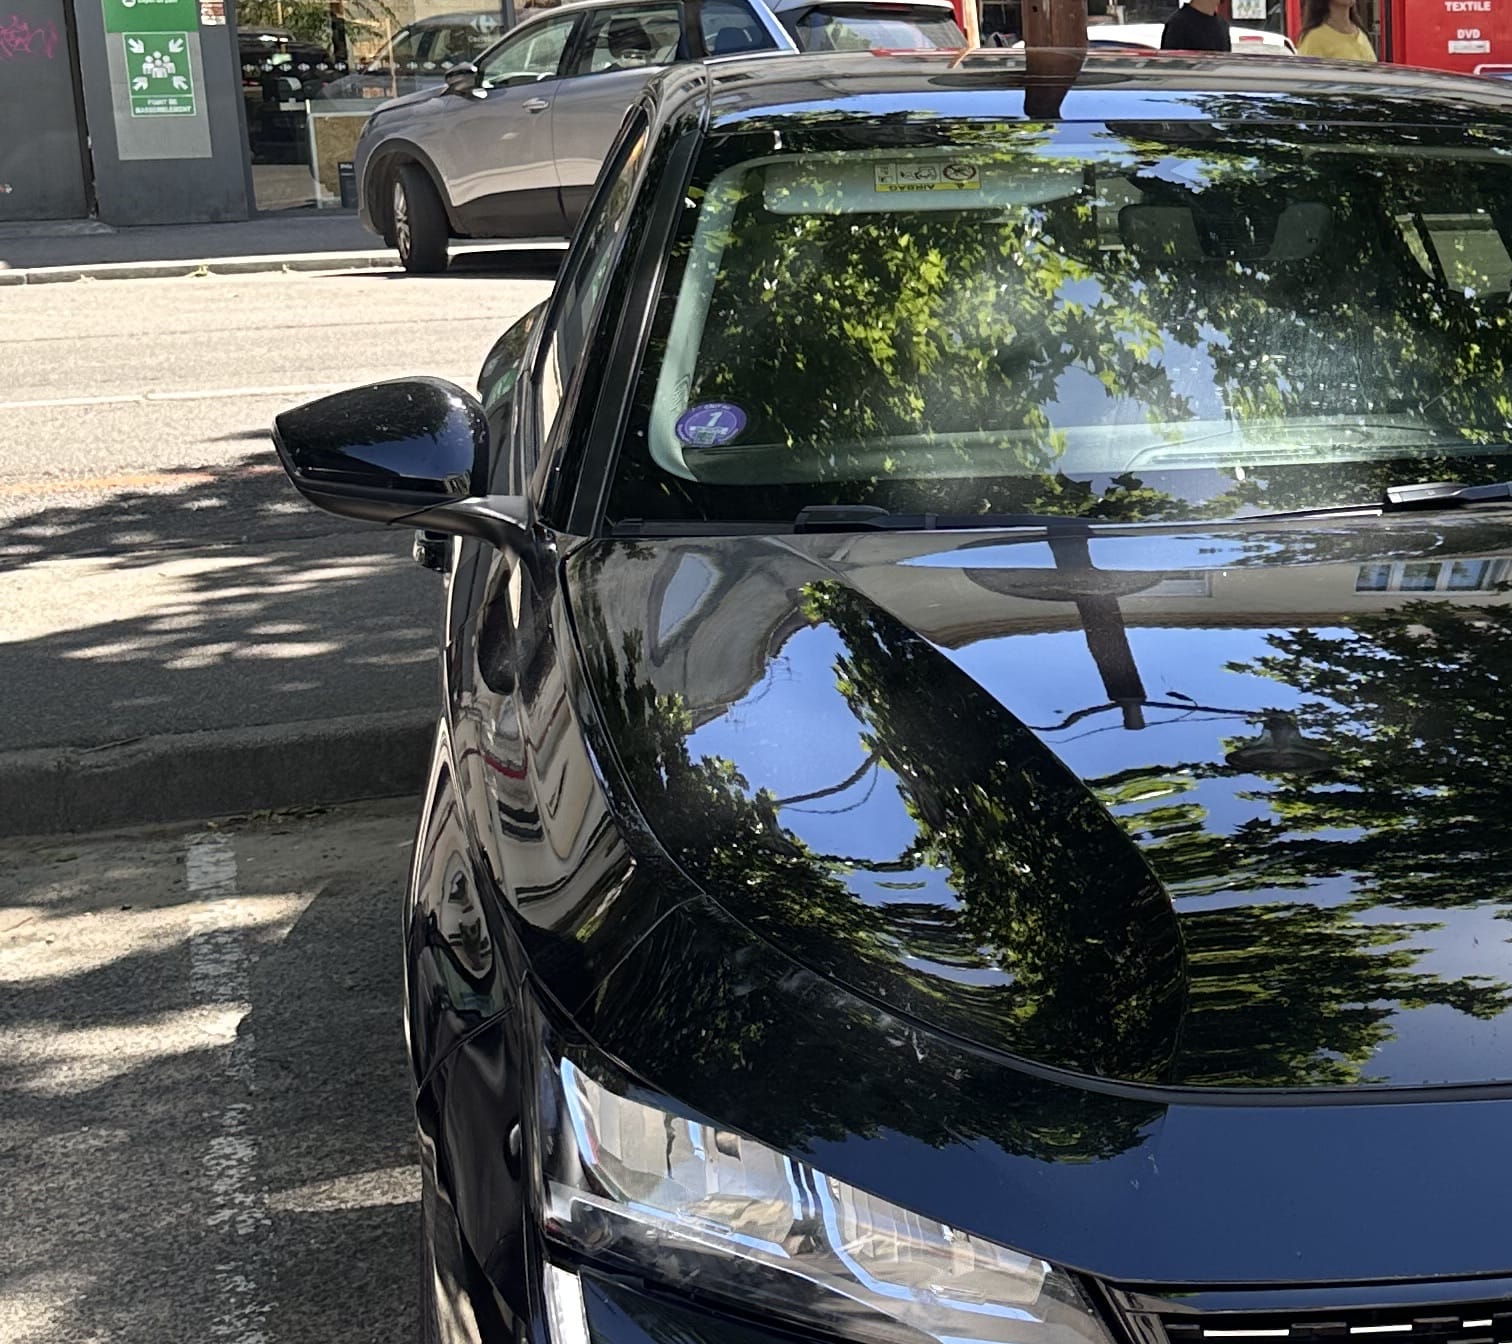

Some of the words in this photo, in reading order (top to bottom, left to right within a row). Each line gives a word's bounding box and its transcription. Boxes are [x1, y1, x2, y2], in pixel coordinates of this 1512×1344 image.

[1444, 1, 1491, 12] TEXTILE
[1457, 29, 1481, 39] DVD
[888, 183, 936, 192] AIRBAG
